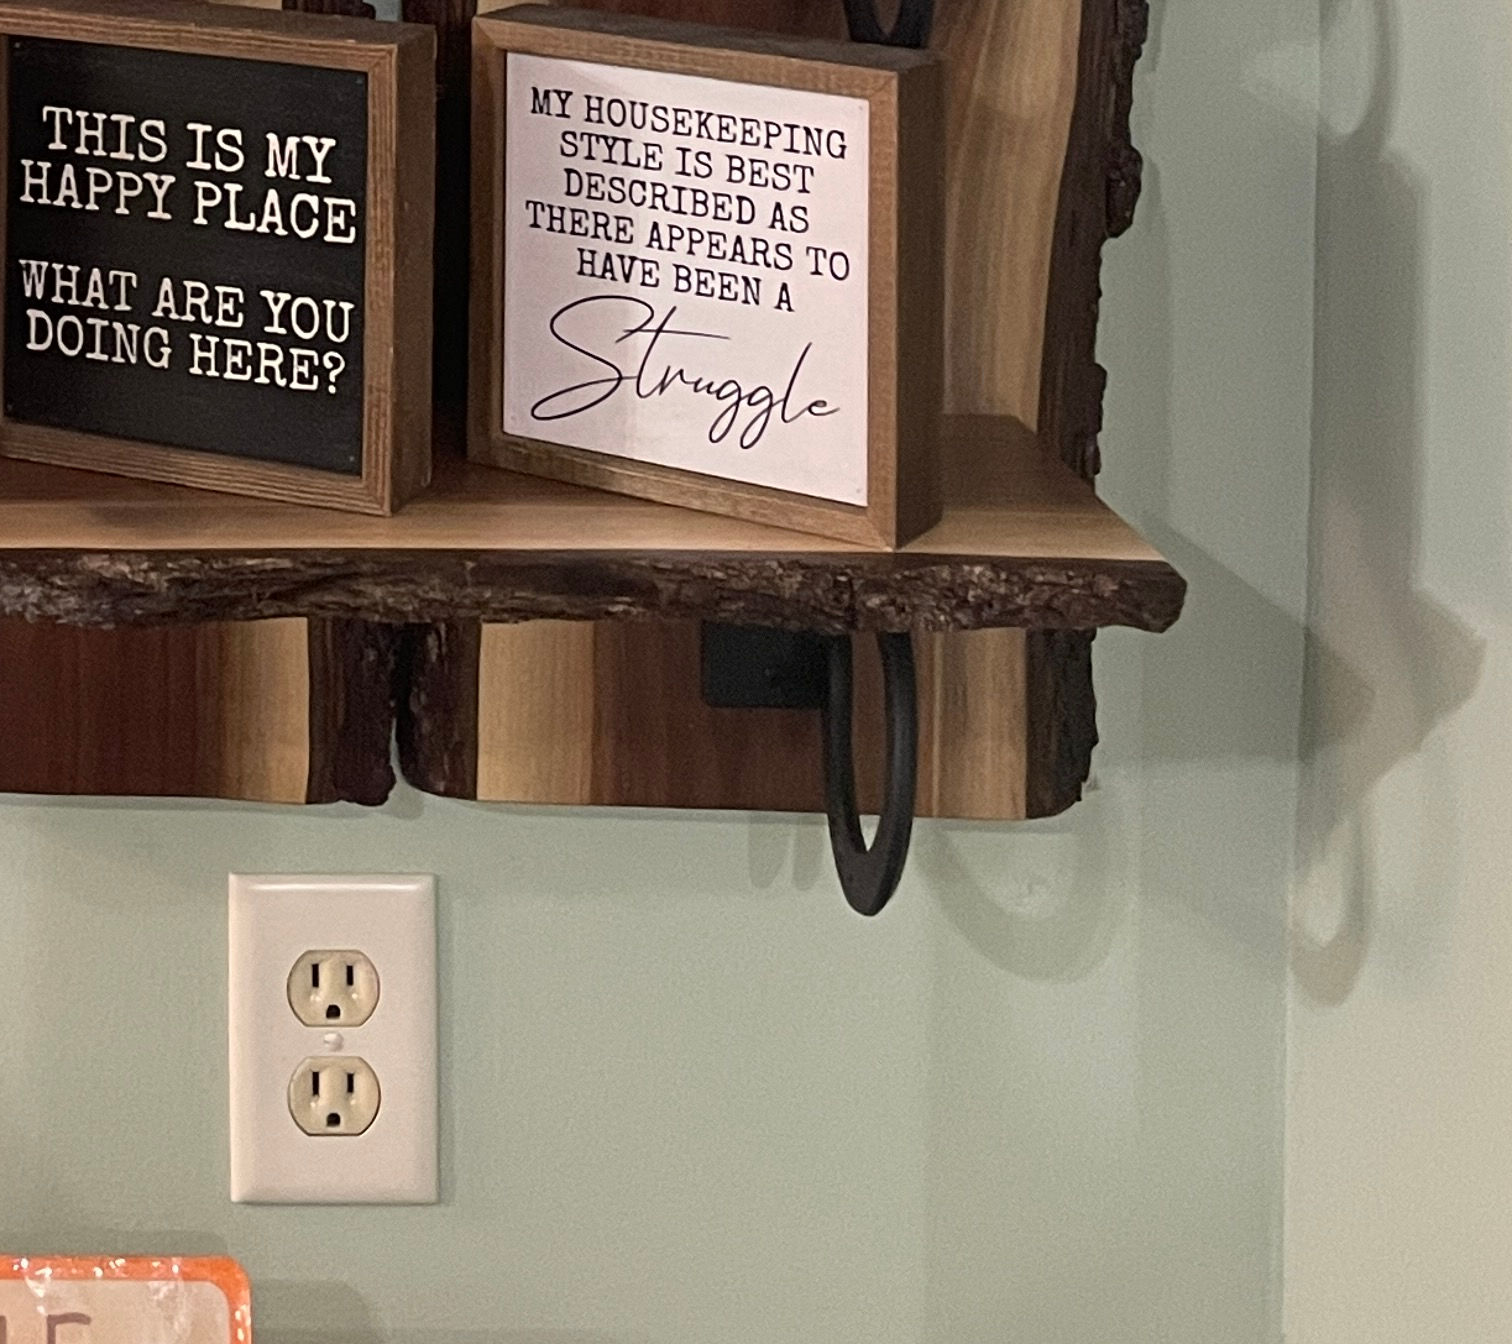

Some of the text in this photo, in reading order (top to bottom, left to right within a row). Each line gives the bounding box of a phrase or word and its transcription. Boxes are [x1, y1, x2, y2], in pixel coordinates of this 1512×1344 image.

[42, 106, 336, 184] THIS IS MY
[531, 87, 847, 160] MY HOUSEKEEPING
[560, 131, 814, 194] STYLE IS BEST
[20, 159, 356, 244] HAPPY PLACE
[564, 168, 809, 233] DESCRIBED AS
[526, 201, 850, 281] THERE APPEARS TO
[577, 248, 795, 312] HAVE BEEN A
[19, 259, 354, 342] WHAT ARE YOU
[26, 309, 346, 394] DOING HERE?
[531, 295, 840, 449] Struggle
